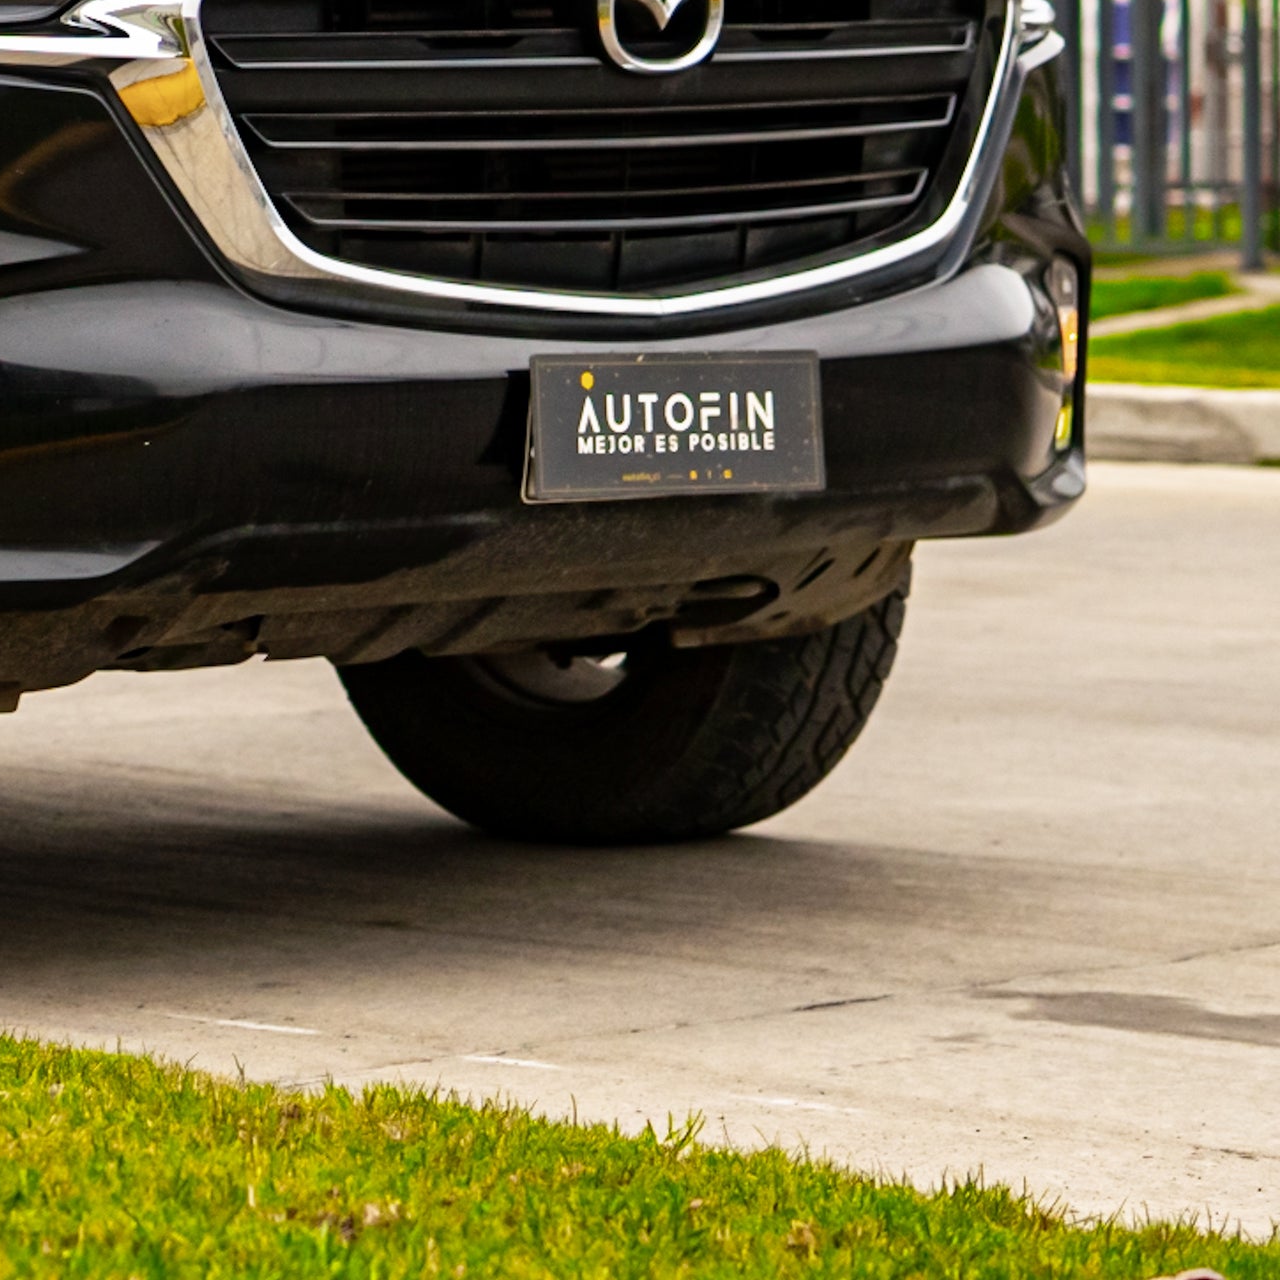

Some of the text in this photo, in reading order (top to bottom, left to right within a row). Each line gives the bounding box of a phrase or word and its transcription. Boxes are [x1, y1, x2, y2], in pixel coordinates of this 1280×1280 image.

[578, 391, 774, 433] AUTOFIN
[578, 432, 775, 454] MEJOR ES POSIBLE
